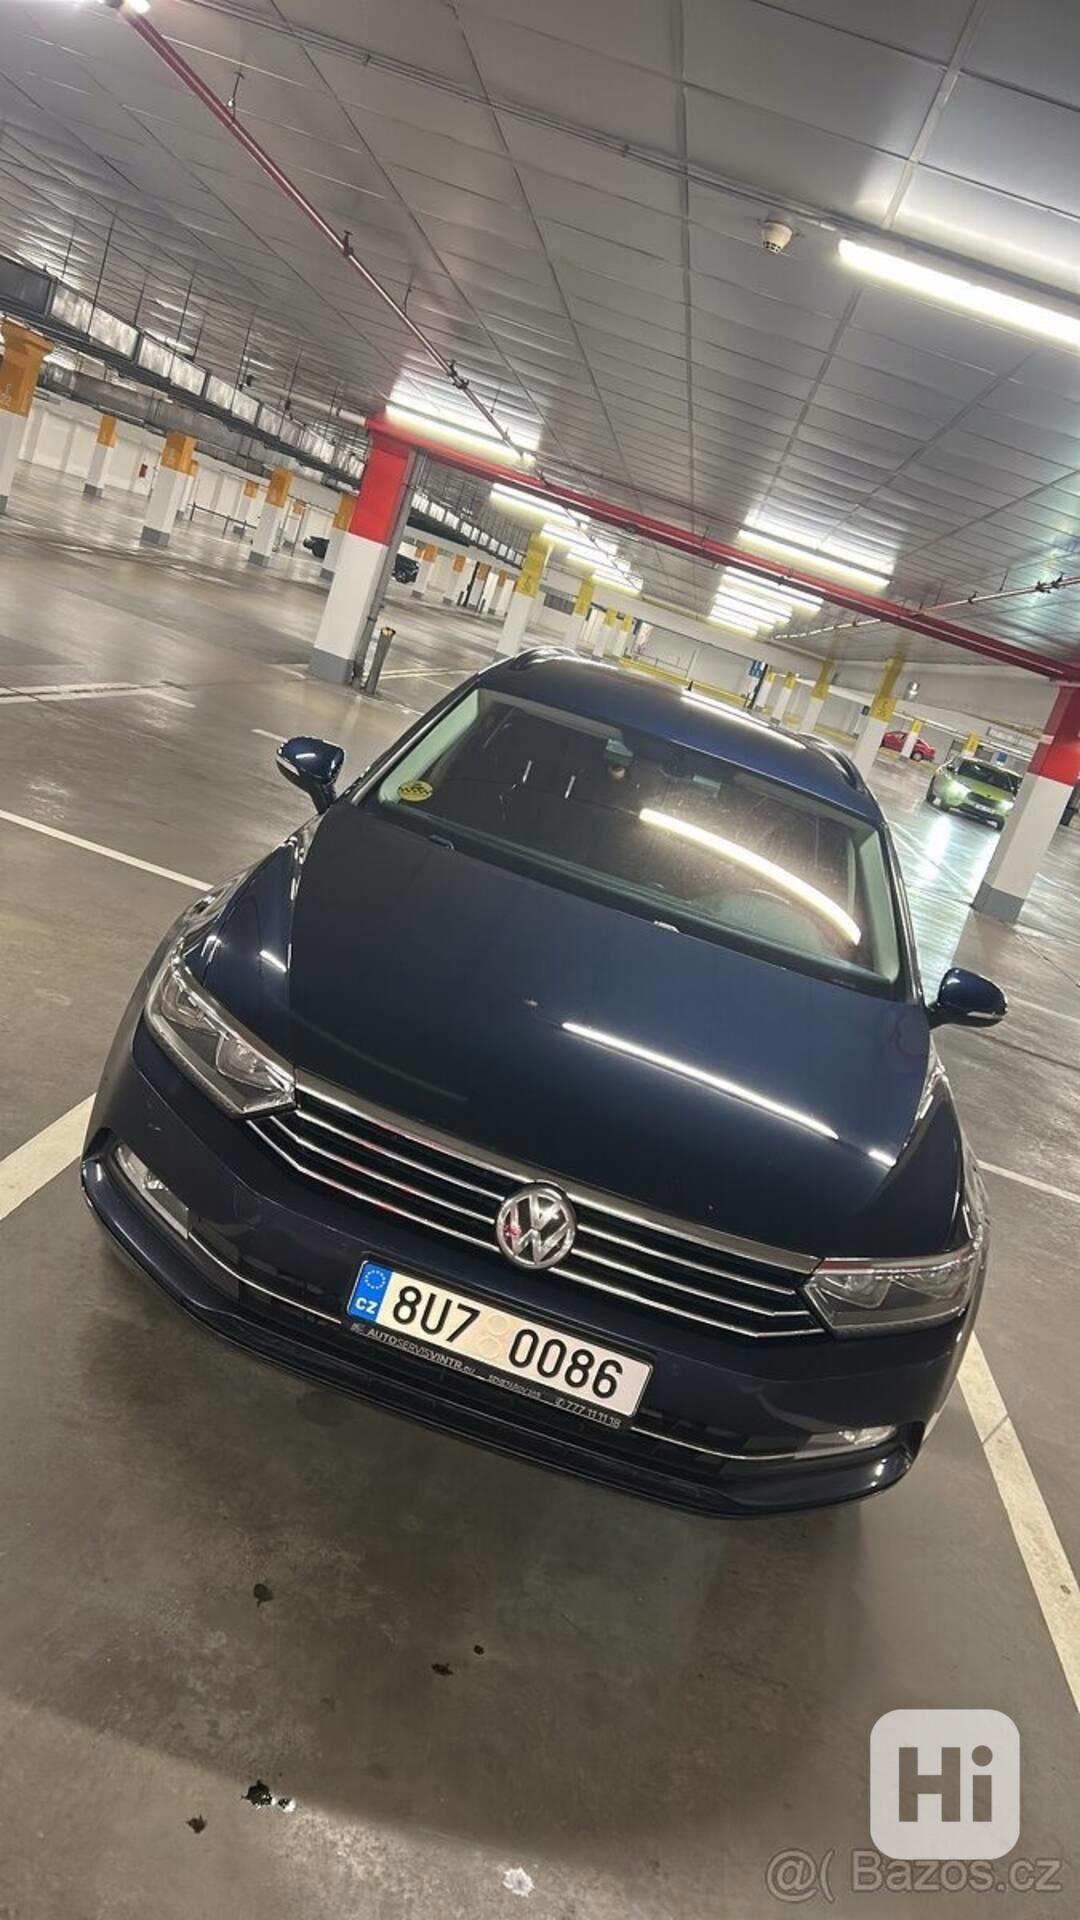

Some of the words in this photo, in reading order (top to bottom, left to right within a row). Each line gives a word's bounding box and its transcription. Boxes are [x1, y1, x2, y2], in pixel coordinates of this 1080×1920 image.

[355, 1296, 378, 1315] CZ
[393, 1286, 480, 1342] 8U7
[509, 1329, 623, 1398] 0086
